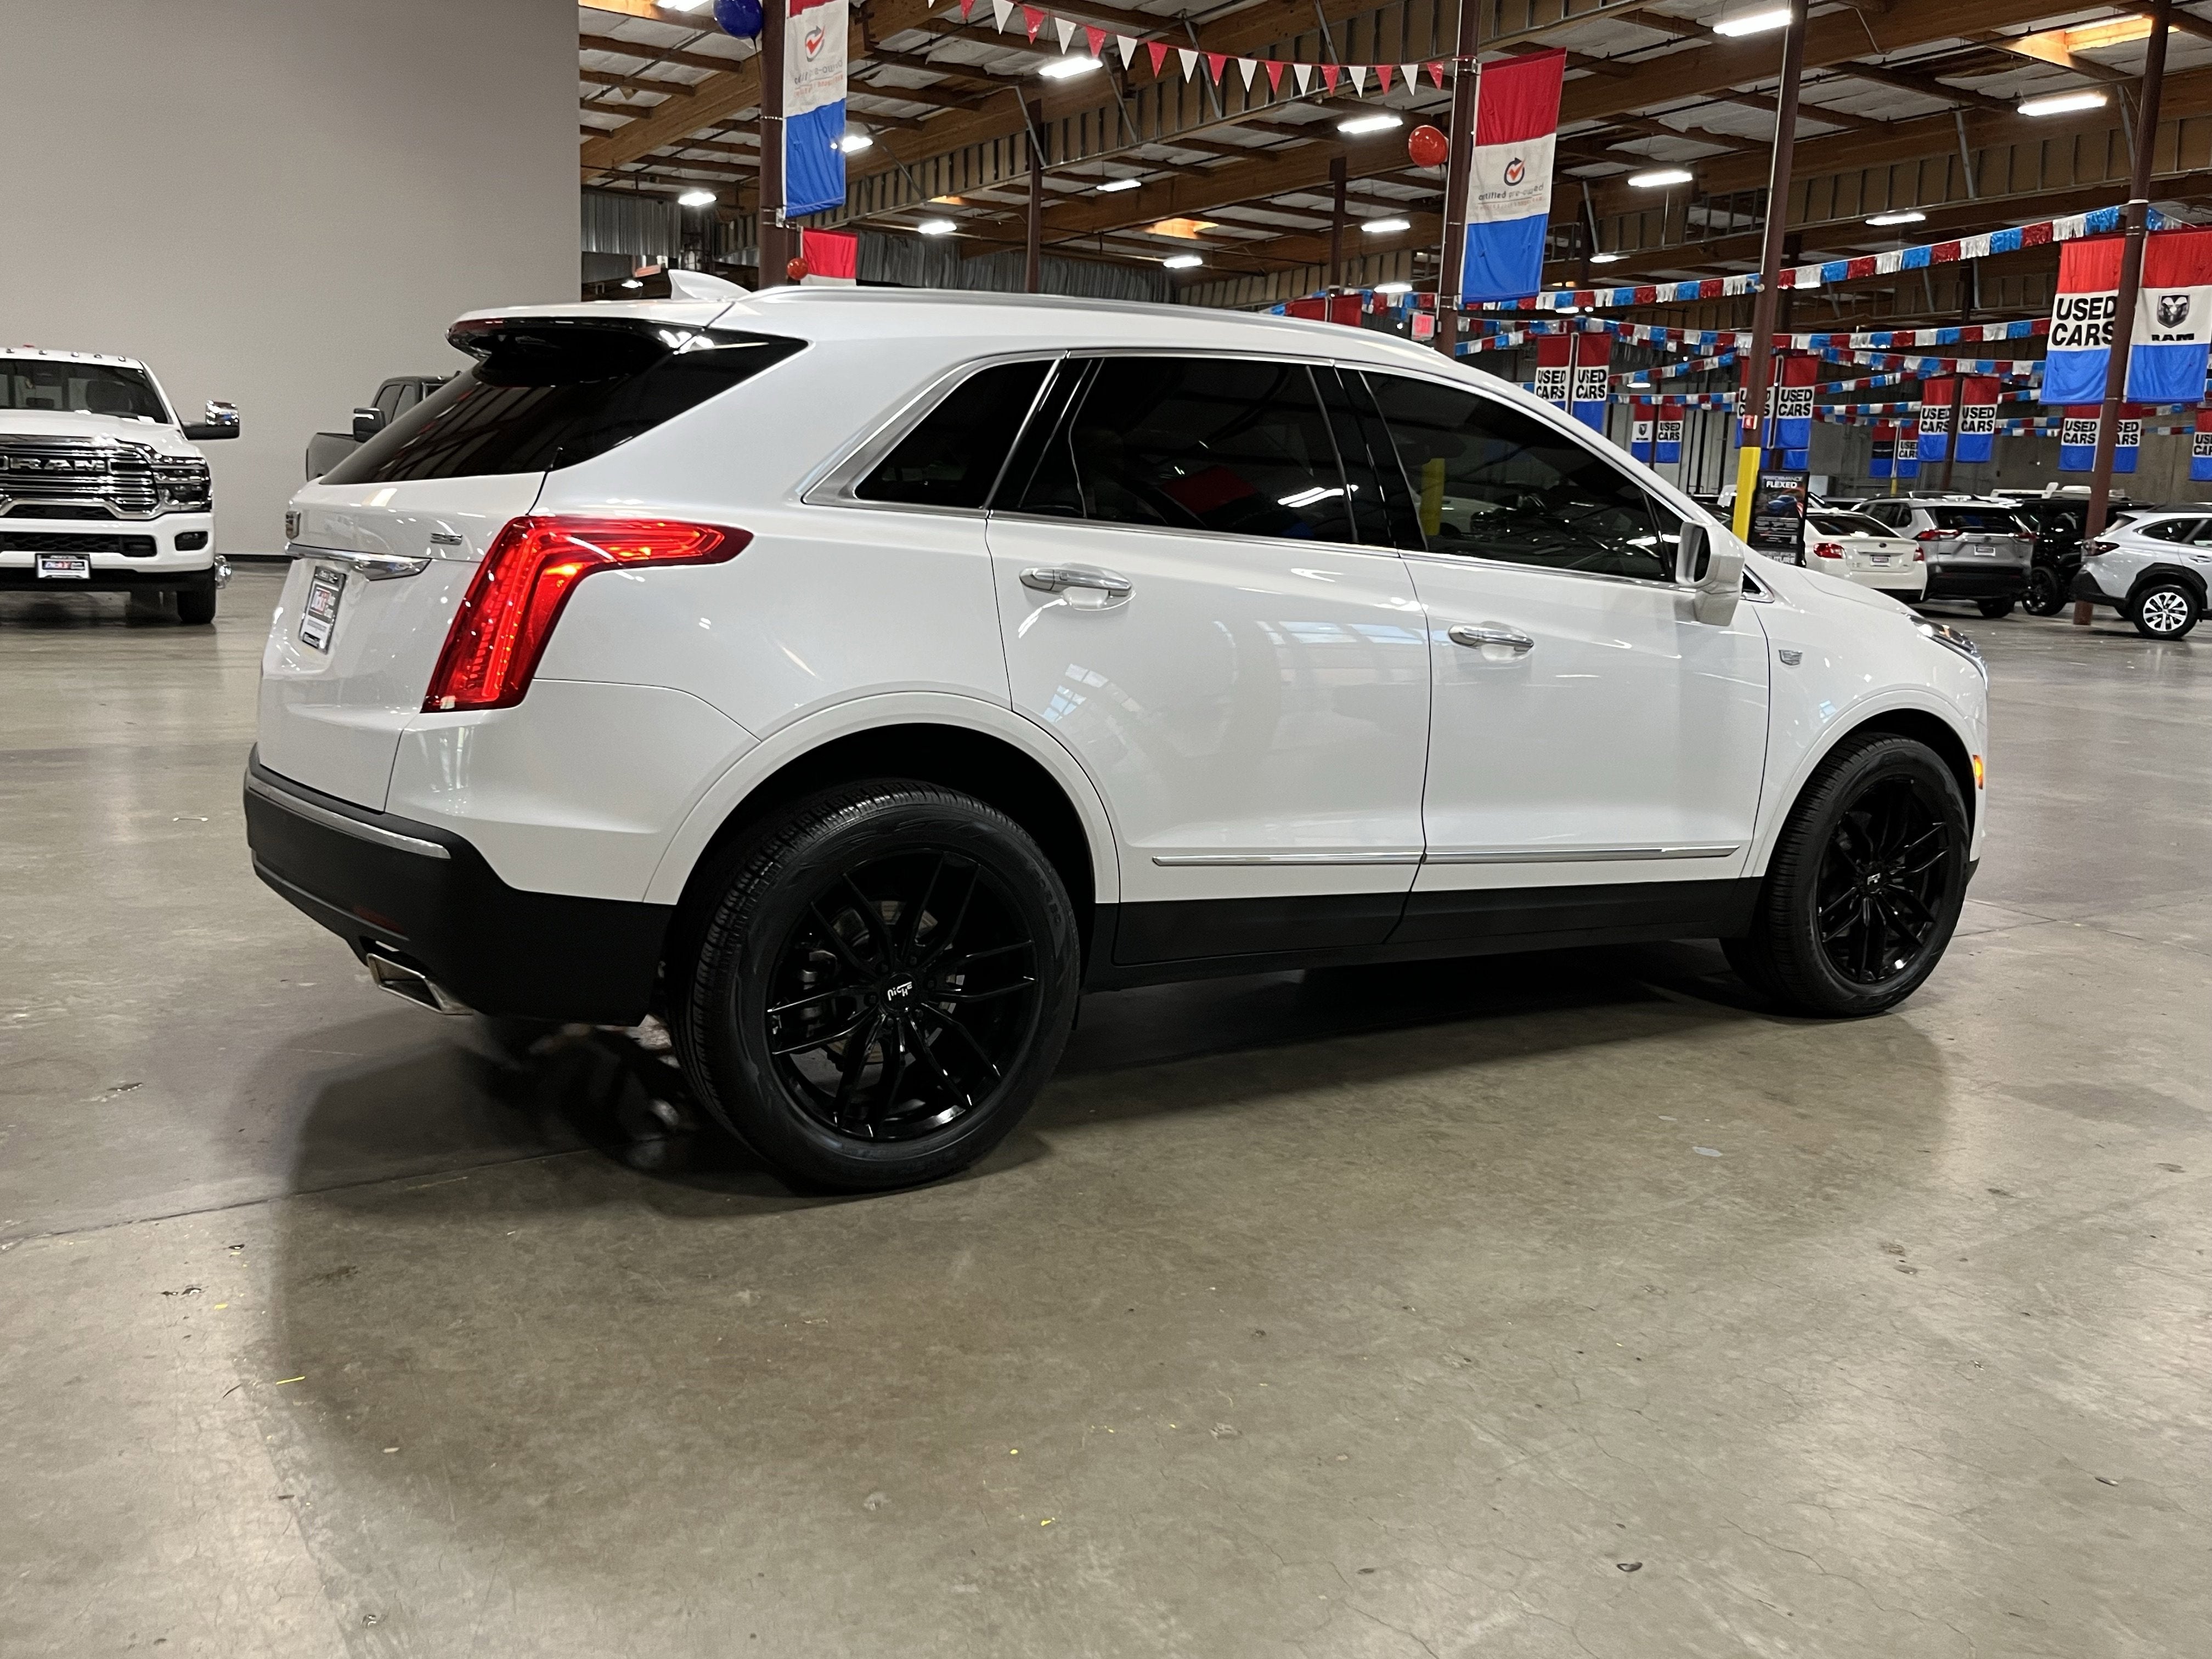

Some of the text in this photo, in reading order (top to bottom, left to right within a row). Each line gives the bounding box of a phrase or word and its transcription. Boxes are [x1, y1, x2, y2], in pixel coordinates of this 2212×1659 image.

[2056, 296, 2117, 321] USED
[2051, 321, 2113, 346] CARS
[2151, 333, 2194, 341] RAM
[1538, 370, 1566, 383] USED
[1578, 369, 1607, 383] USED
[1536, 385, 1565, 399] CARS
[1576, 385, 1606, 399] CARS
[1781, 389, 1813, 402] USED
[1779, 403, 1811, 416] CARS
[1922, 408, 1951, 419] USED
[1962, 407, 1995, 419] USED
[1660, 422, 1680, 431] USED
[1921, 421, 1949, 432] CARS
[1961, 420, 1993, 432] CARS
[2065, 420, 2097, 431] USED
[2117, 421, 2139, 432] SED
[1658, 432, 1680, 441] CARS
[2063, 433, 2095, 444] CARS
[1900, 441, 1917, 449] USE
[10, 457, 105, 471] RAM
[1766, 481, 1798, 489] FLEXED
